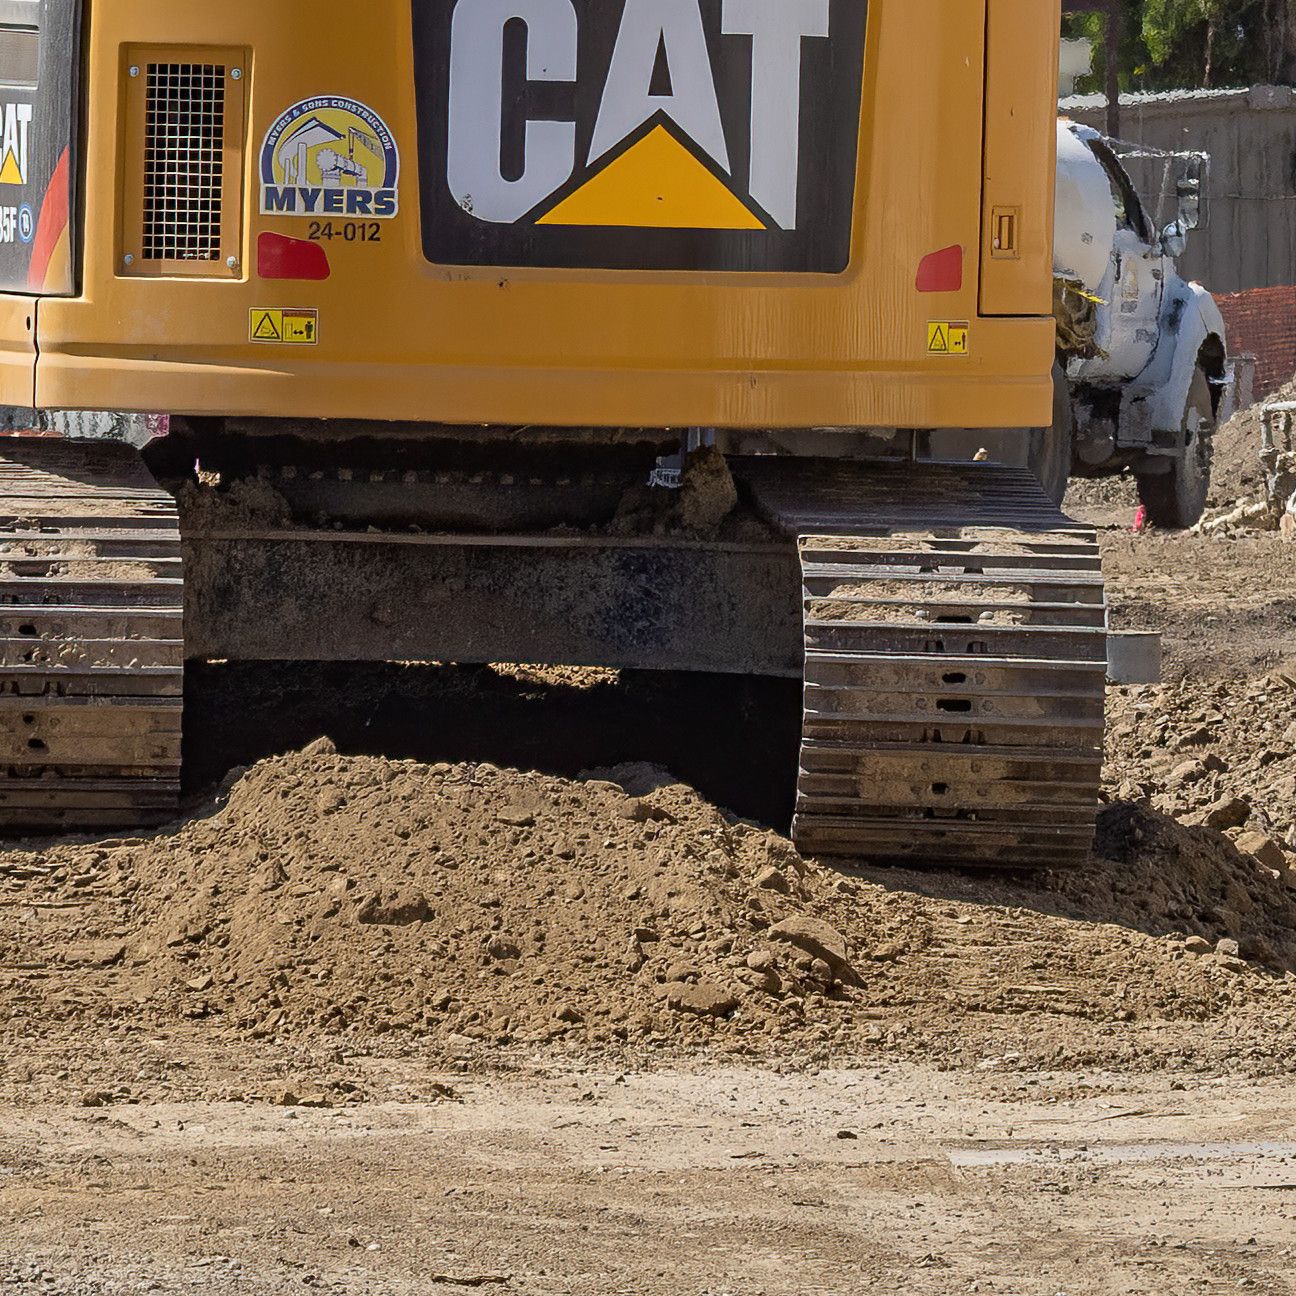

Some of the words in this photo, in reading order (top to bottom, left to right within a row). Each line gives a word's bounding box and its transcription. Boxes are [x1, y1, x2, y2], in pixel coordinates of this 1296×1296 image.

[267, 115, 292, 146] MYERS
[302, 99, 329, 112] SONS
[331, 99, 393, 150] CONSTRUCTION
[265, 186, 396, 215] MYERS
[308, 222, 381, 242] 24-012
